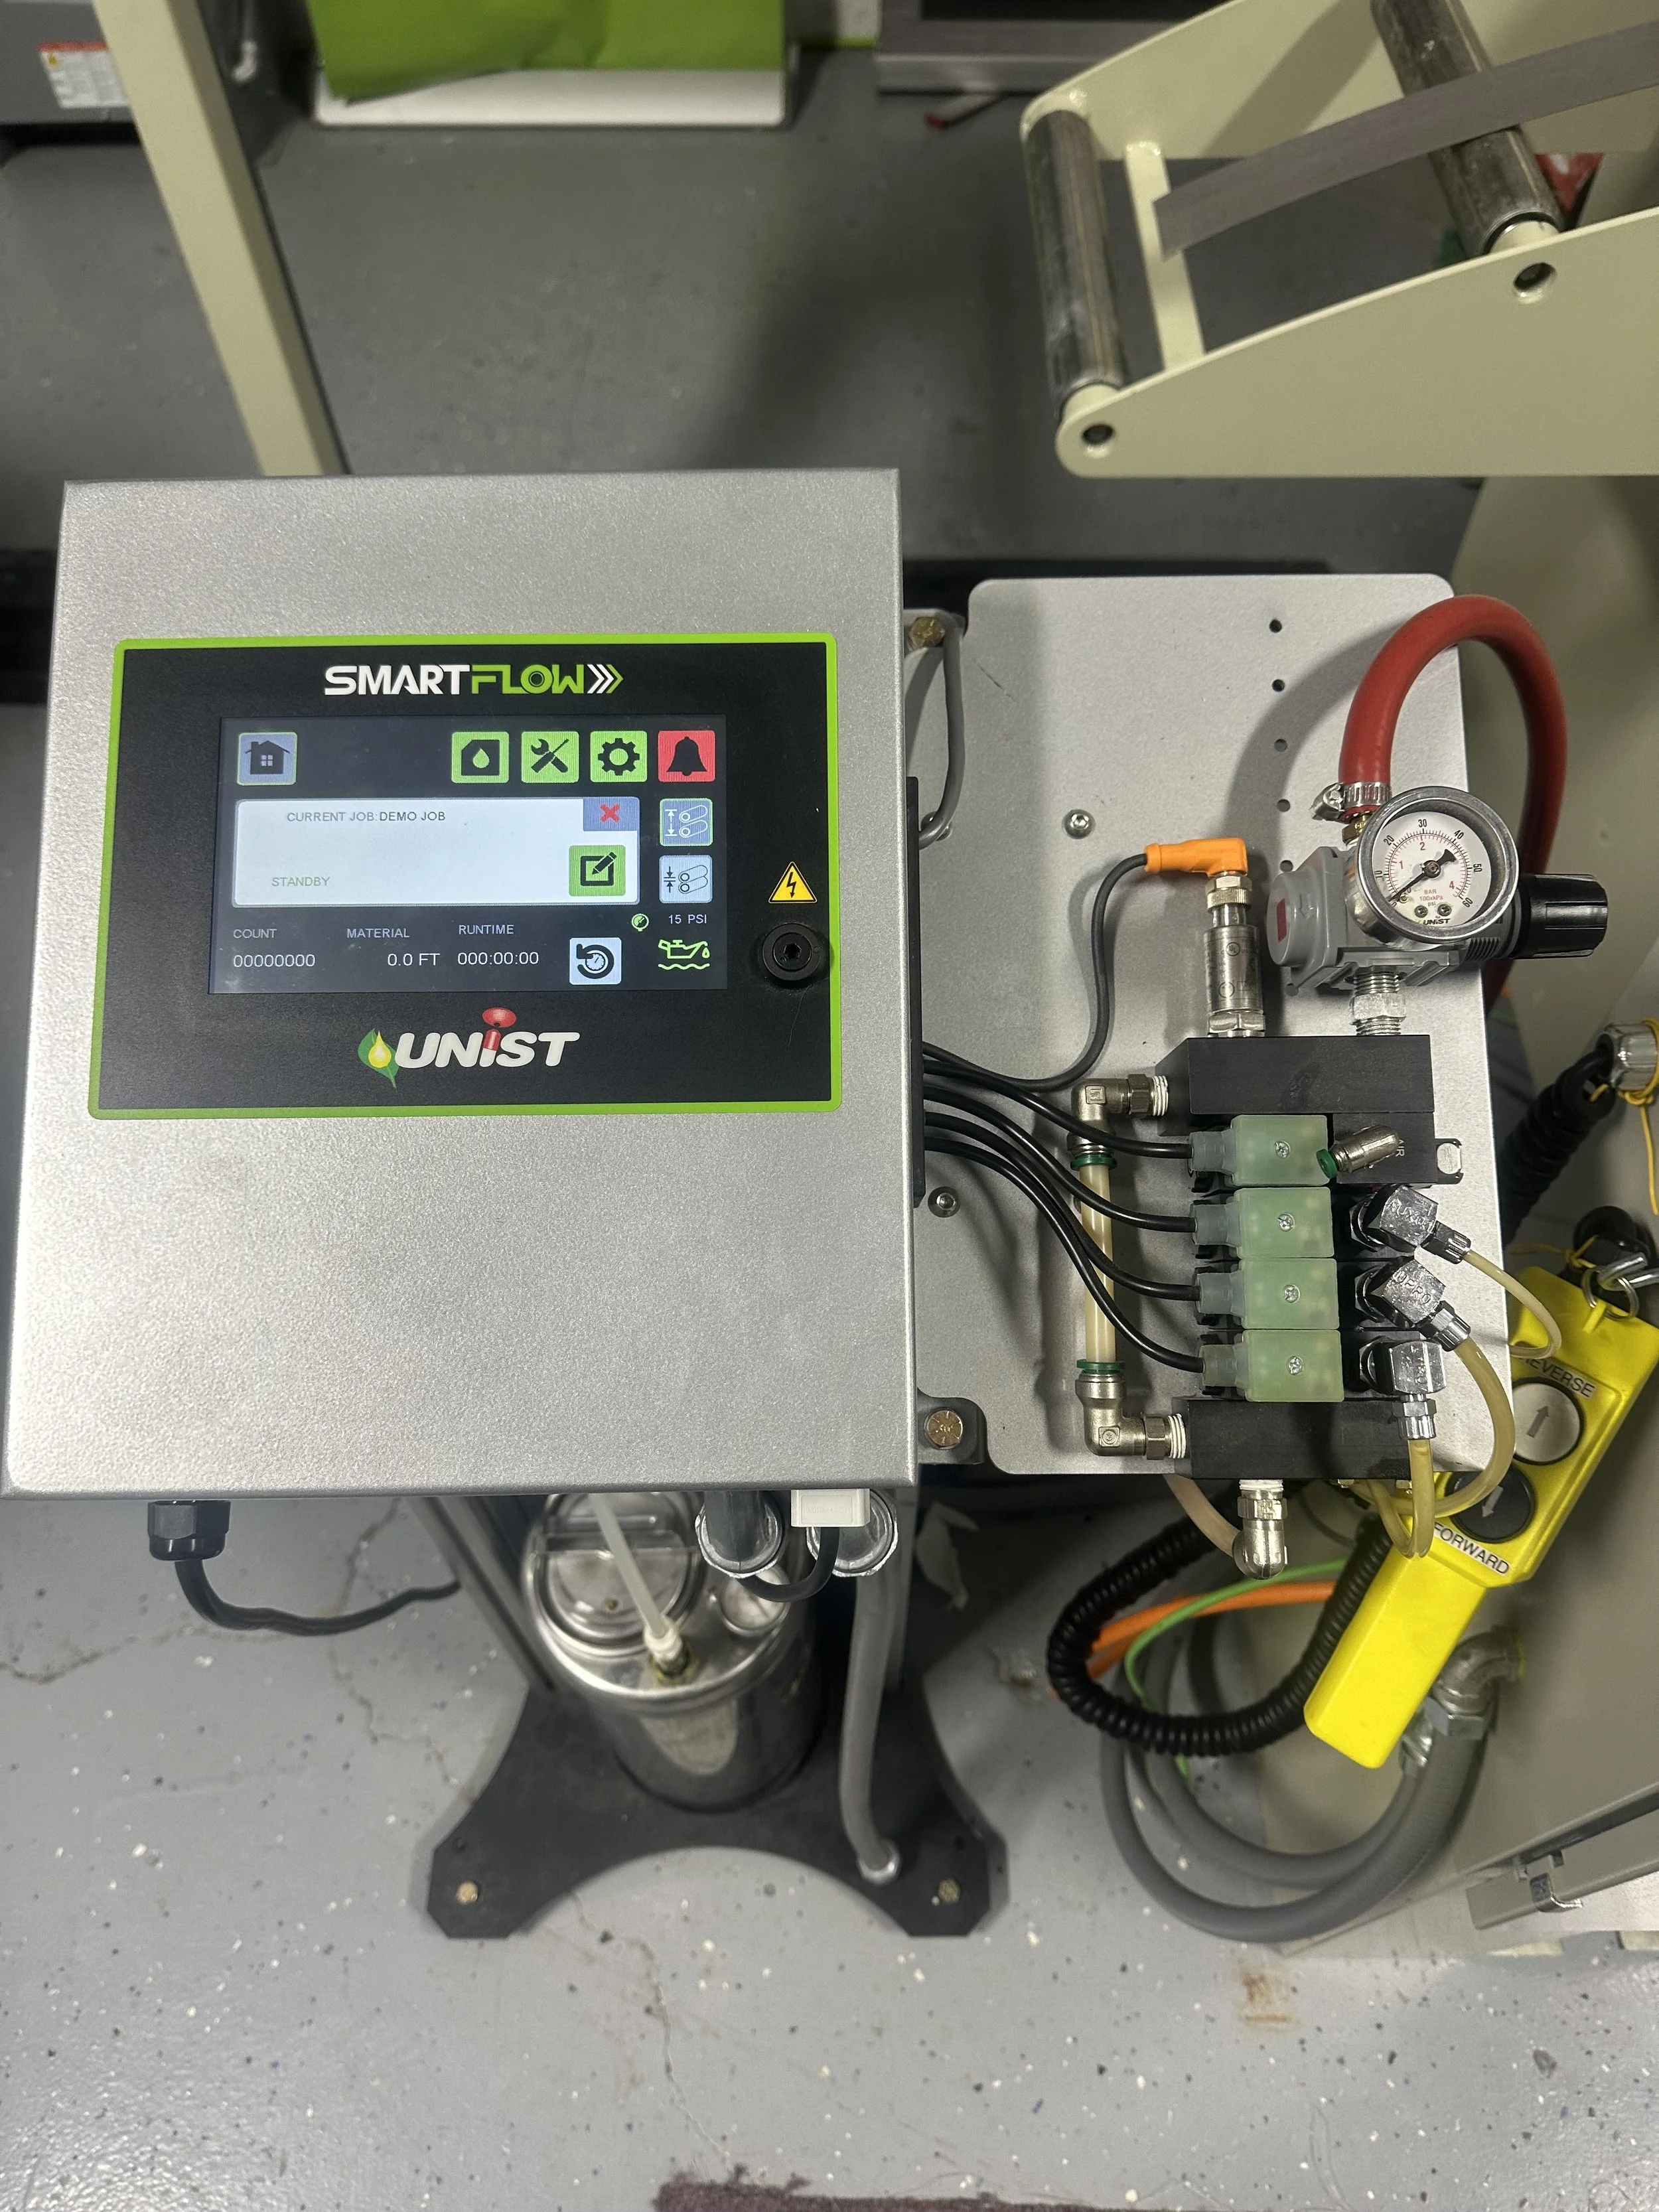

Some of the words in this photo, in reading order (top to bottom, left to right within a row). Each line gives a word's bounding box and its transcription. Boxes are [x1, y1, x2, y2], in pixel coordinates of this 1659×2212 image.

[286, 812, 346, 822] CURRENT
[421, 811, 446, 821] JOB
[1418, 818, 1427, 828] 30
[1453, 830, 1465, 840] 40
[1383, 835, 1394, 846] 20
[1419, 842, 1426, 851] 2
[1398, 860, 1404, 869] 1
[1473, 863, 1482, 873] 50
[1374, 870, 1383, 879] 10
[271, 877, 331, 887] STANDBY
[1449, 880, 1455, 889] 4
[1462, 897, 1473, 908] 60
[668, 914, 682, 924] 15
[687, 914, 707, 924] PSI
[233, 928, 277, 939] COUNT
[346, 928, 410, 938] MATERIAL
[459, 924, 514, 935] RUNTIME
[233, 954, 316, 968] 00000000
[387, 952, 413, 966] 0.0
[418, 952, 441, 966] FT
[457, 951, 540, 966] 000:00:00
